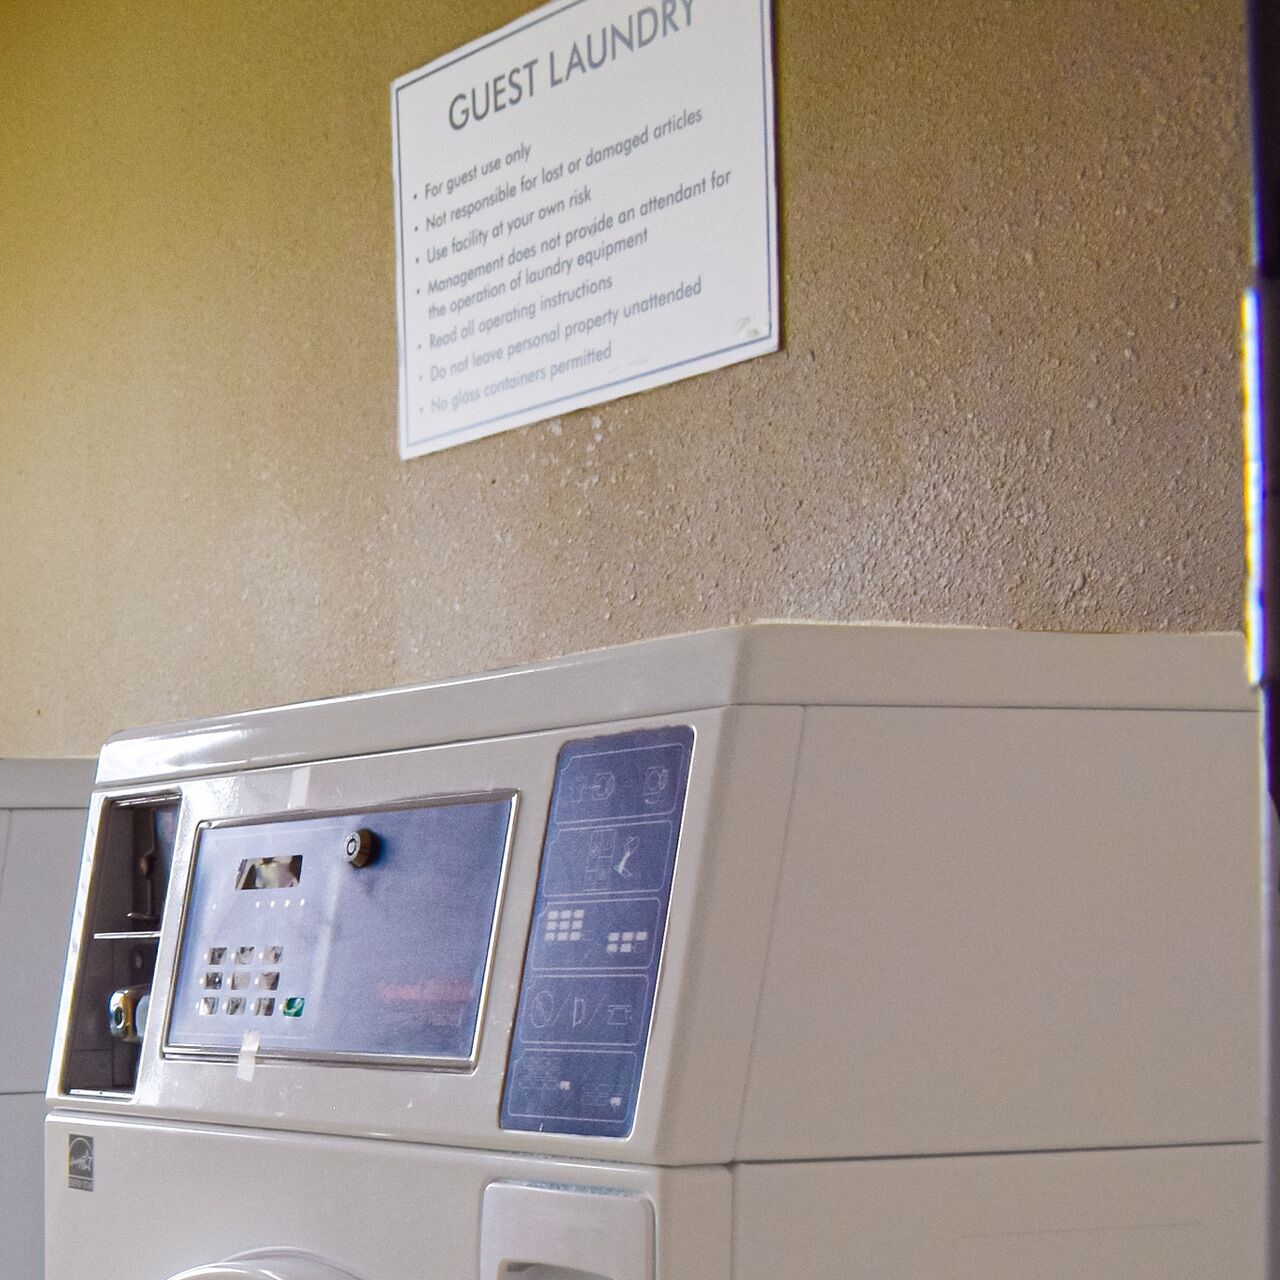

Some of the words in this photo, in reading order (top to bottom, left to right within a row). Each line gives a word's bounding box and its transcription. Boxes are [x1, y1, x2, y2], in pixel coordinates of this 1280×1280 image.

[449, 59, 538, 130] GUEST
[550, 0, 695, 88] LAUNDRY
[425, 183, 443, 200] For
[447, 166, 477, 194] guest
[481, 157, 501, 175] use
[506, 142, 531, 165] only
[426, 212, 447, 231] Not
[451, 182, 517, 219] responsible
[520, 175, 538, 192] for
[542, 162, 563, 184] lost
[567, 158, 581, 174] or
[585, 124, 649, 167] damaged
[653, 108, 702, 140] articles
[427, 247, 448, 264] Use
[451, 229, 488, 254] facility
[492, 221, 504, 238] at
[507, 211, 534, 236] your
[538, 200, 565, 219] own
[569, 185, 592, 208] risk
[428, 254, 503, 295] Management
[508, 245, 536, 265] does
[540, 232, 561, 253] not
[565, 213, 613, 248] provide
[618, 208, 635, 224] an
[640, 177, 706, 216] attendant
[711, 170, 731, 190] for
[428, 303, 446, 320] the
[450, 282, 506, 314] operation
[510, 270, 522, 290] of
[526, 257, 572, 285] laundry
[577, 228, 648, 267] equipment
[429, 325, 457, 349] Read
[461, 320, 475, 339] all
[479, 303, 536, 334] operating
[540, 275, 613, 311] instructions
[430, 365, 446, 382] Do
[450, 357, 469, 375] not
[472, 348, 503, 368] leave
[507, 323, 560, 360] personal
[564, 309, 619, 343] property
[623, 274, 701, 318] unattended
[432, 399, 448, 414] No
[452, 388, 480, 411] glass
[483, 367, 546, 397] containers
[550, 340, 612, 381] permitted
